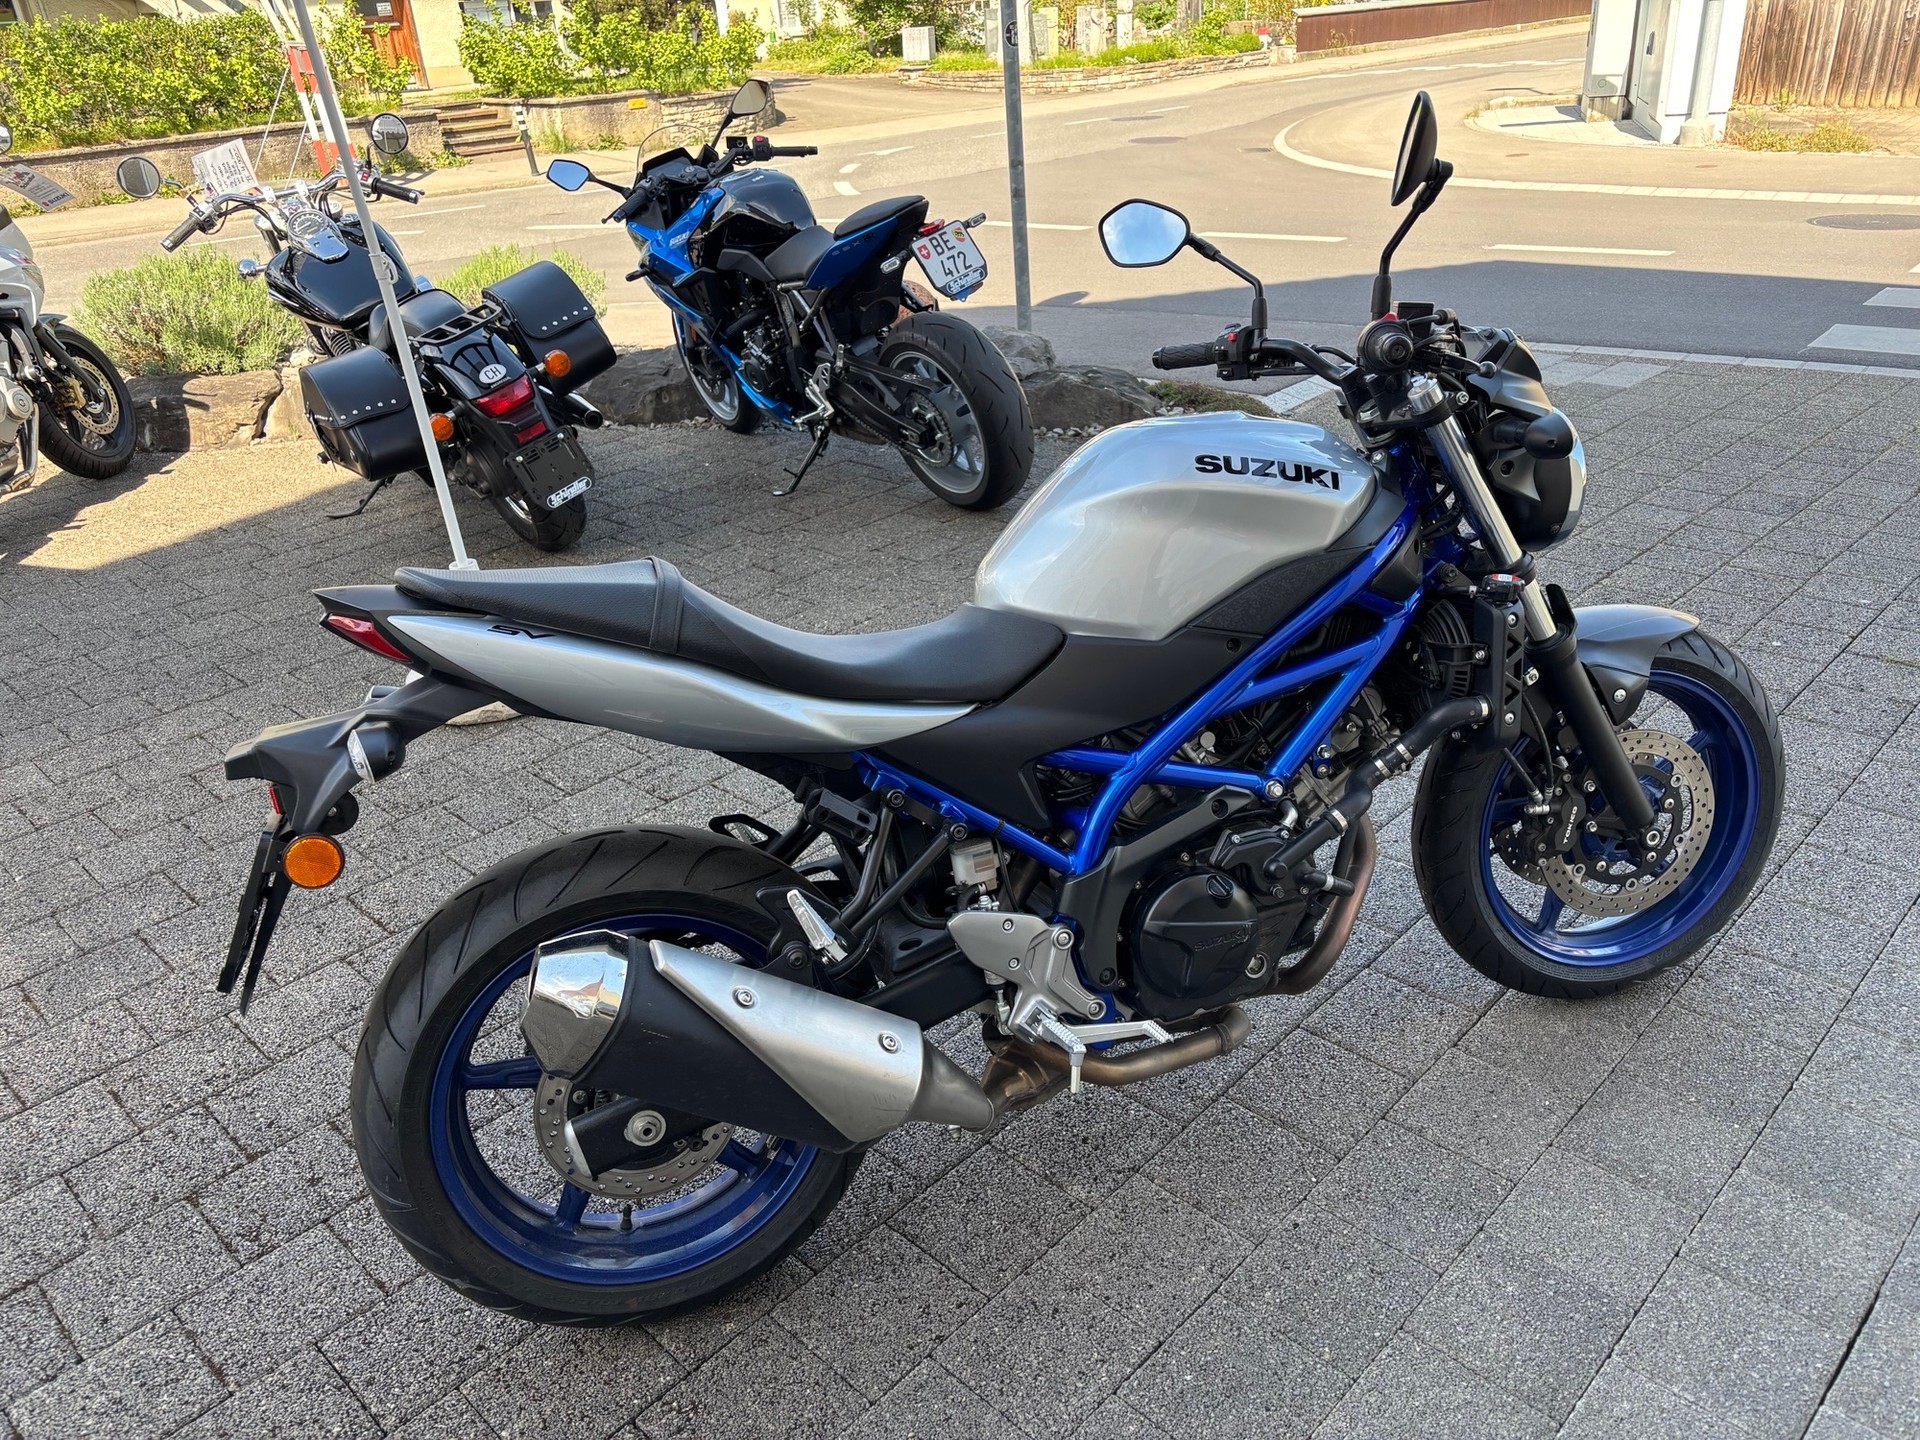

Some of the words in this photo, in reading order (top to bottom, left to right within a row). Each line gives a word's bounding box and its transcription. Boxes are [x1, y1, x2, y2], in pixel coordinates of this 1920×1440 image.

[928, 231, 956, 256] BE
[941, 251, 973, 277] 472
[484, 366, 502, 380] CH
[1194, 454, 1341, 491] SUZUKI
[550, 479, 589, 504] Schindler
[486, 624, 557, 640] SV
[1562, 806, 1578, 844] TOKICO
